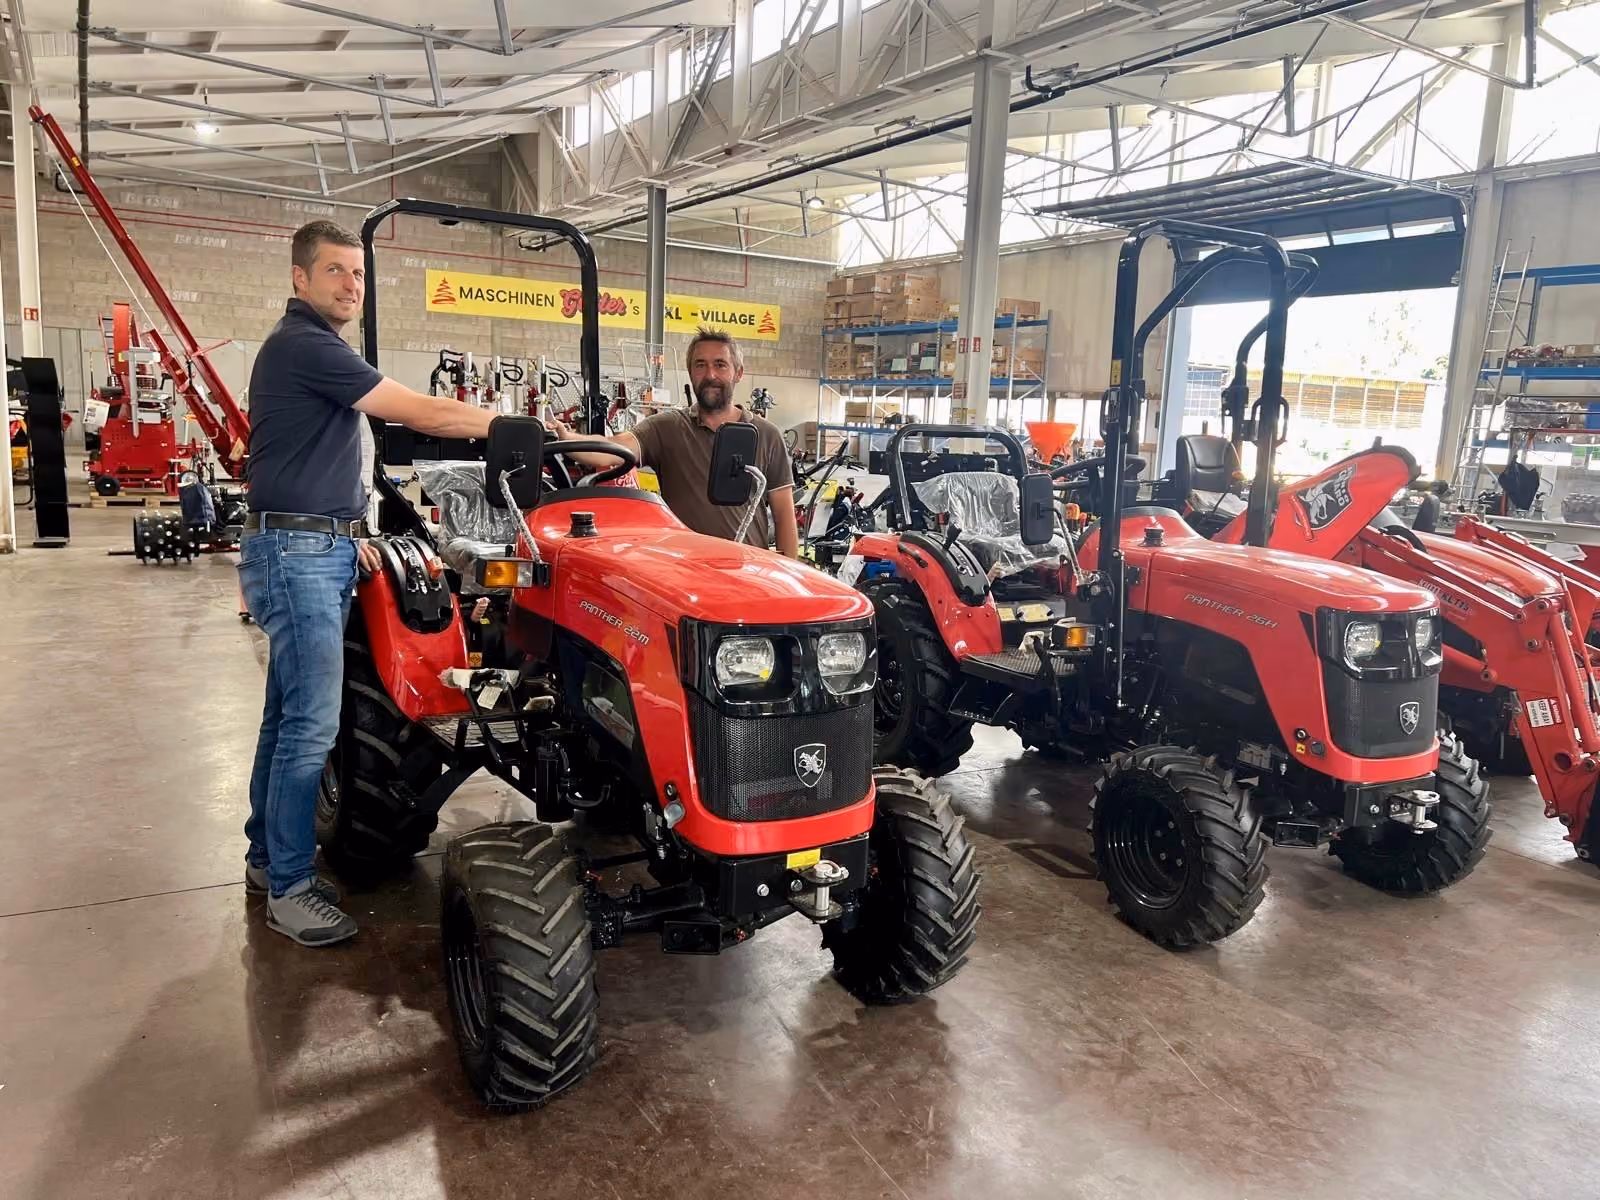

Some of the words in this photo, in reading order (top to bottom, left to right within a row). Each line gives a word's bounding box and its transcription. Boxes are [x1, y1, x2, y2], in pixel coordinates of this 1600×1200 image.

[459, 286, 555, 308] MASCHINEN
[700, 309, 755, 326] VILLAGE
[579, 600, 624, 629] PANTHER
[623, 625, 650, 646] 22M
[1183, 593, 1244, 617] PANTHER
